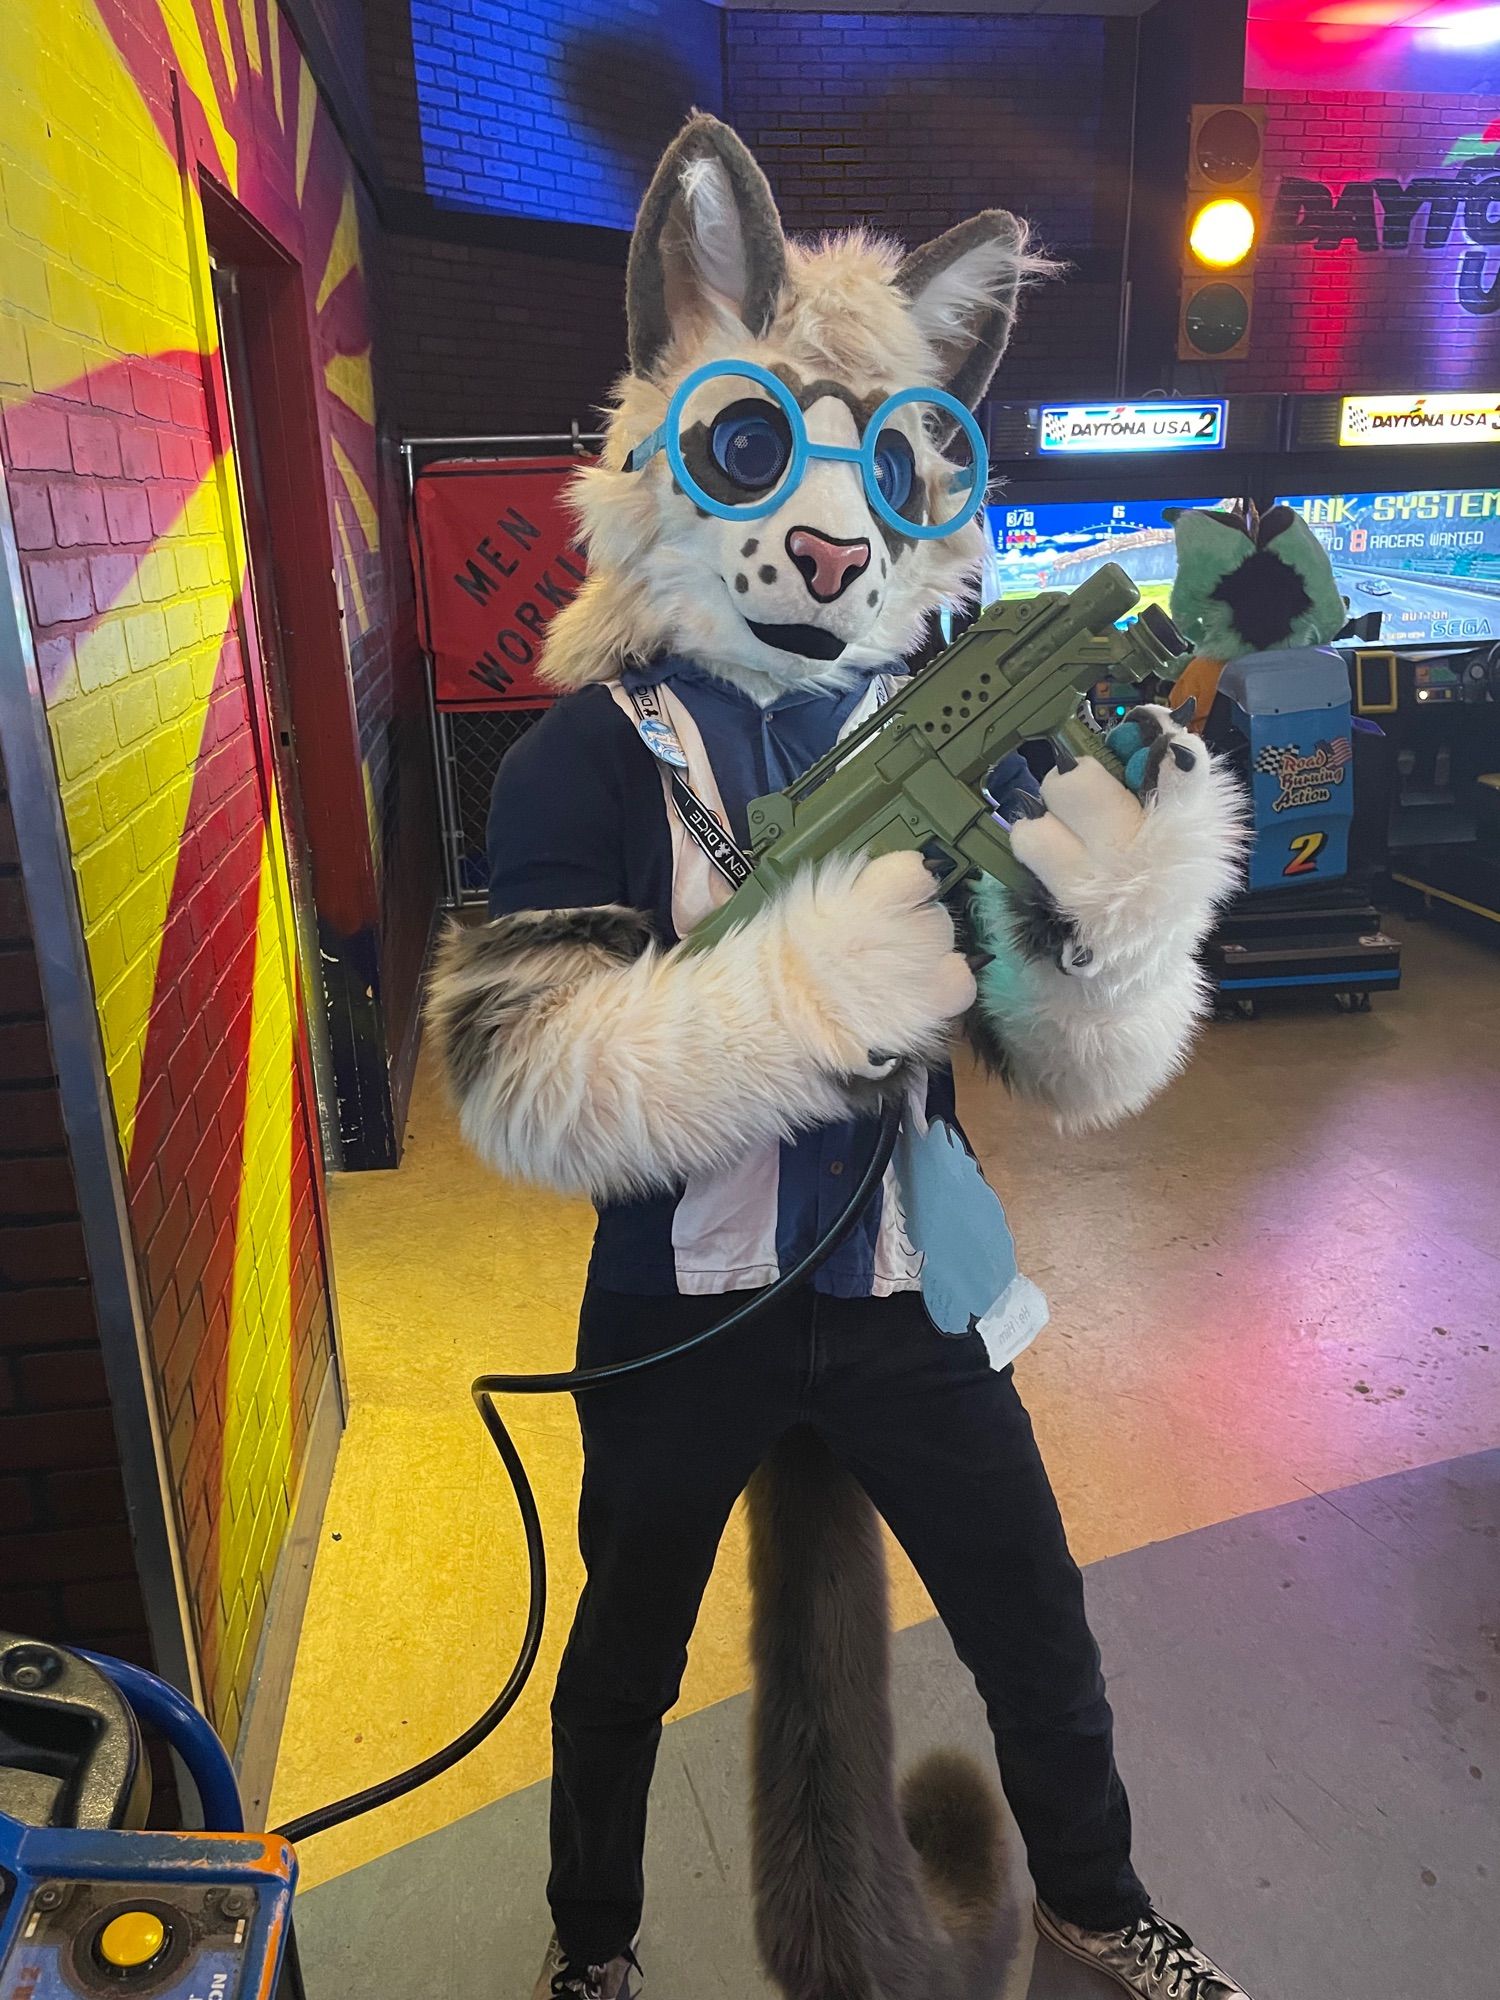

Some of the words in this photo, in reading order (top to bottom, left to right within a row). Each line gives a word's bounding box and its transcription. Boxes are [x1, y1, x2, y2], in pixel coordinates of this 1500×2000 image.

[1070, 421, 1146, 437] DAYTONA
[1153, 420, 1192, 435] USA
[1194, 411, 1217, 438] 2
[1371, 413, 1444, 429] DAYTONA
[1450, 412, 1487, 427] USA
[1302, 497, 1359, 524] INK
[1372, 492, 1500, 521] SYSTEM
[1327, 536, 1343, 551] TO
[1349, 529, 1367, 553] 8
[1369, 533, 1425, 549] RACERS
[1429, 530, 1484, 546] WANTED
[454, 507, 541, 607] MEN
[468, 543, 588, 694] WORKI
[1431, 617, 1492, 638] SEGA
[1281, 750, 1327, 772] Road
[1280, 767, 1344, 790] Burning
[1272, 787, 1330, 812] Action
[689, 809, 720, 847] DICE
[1283, 831, 1325, 875] 2
[724, 854, 748, 881] EN
